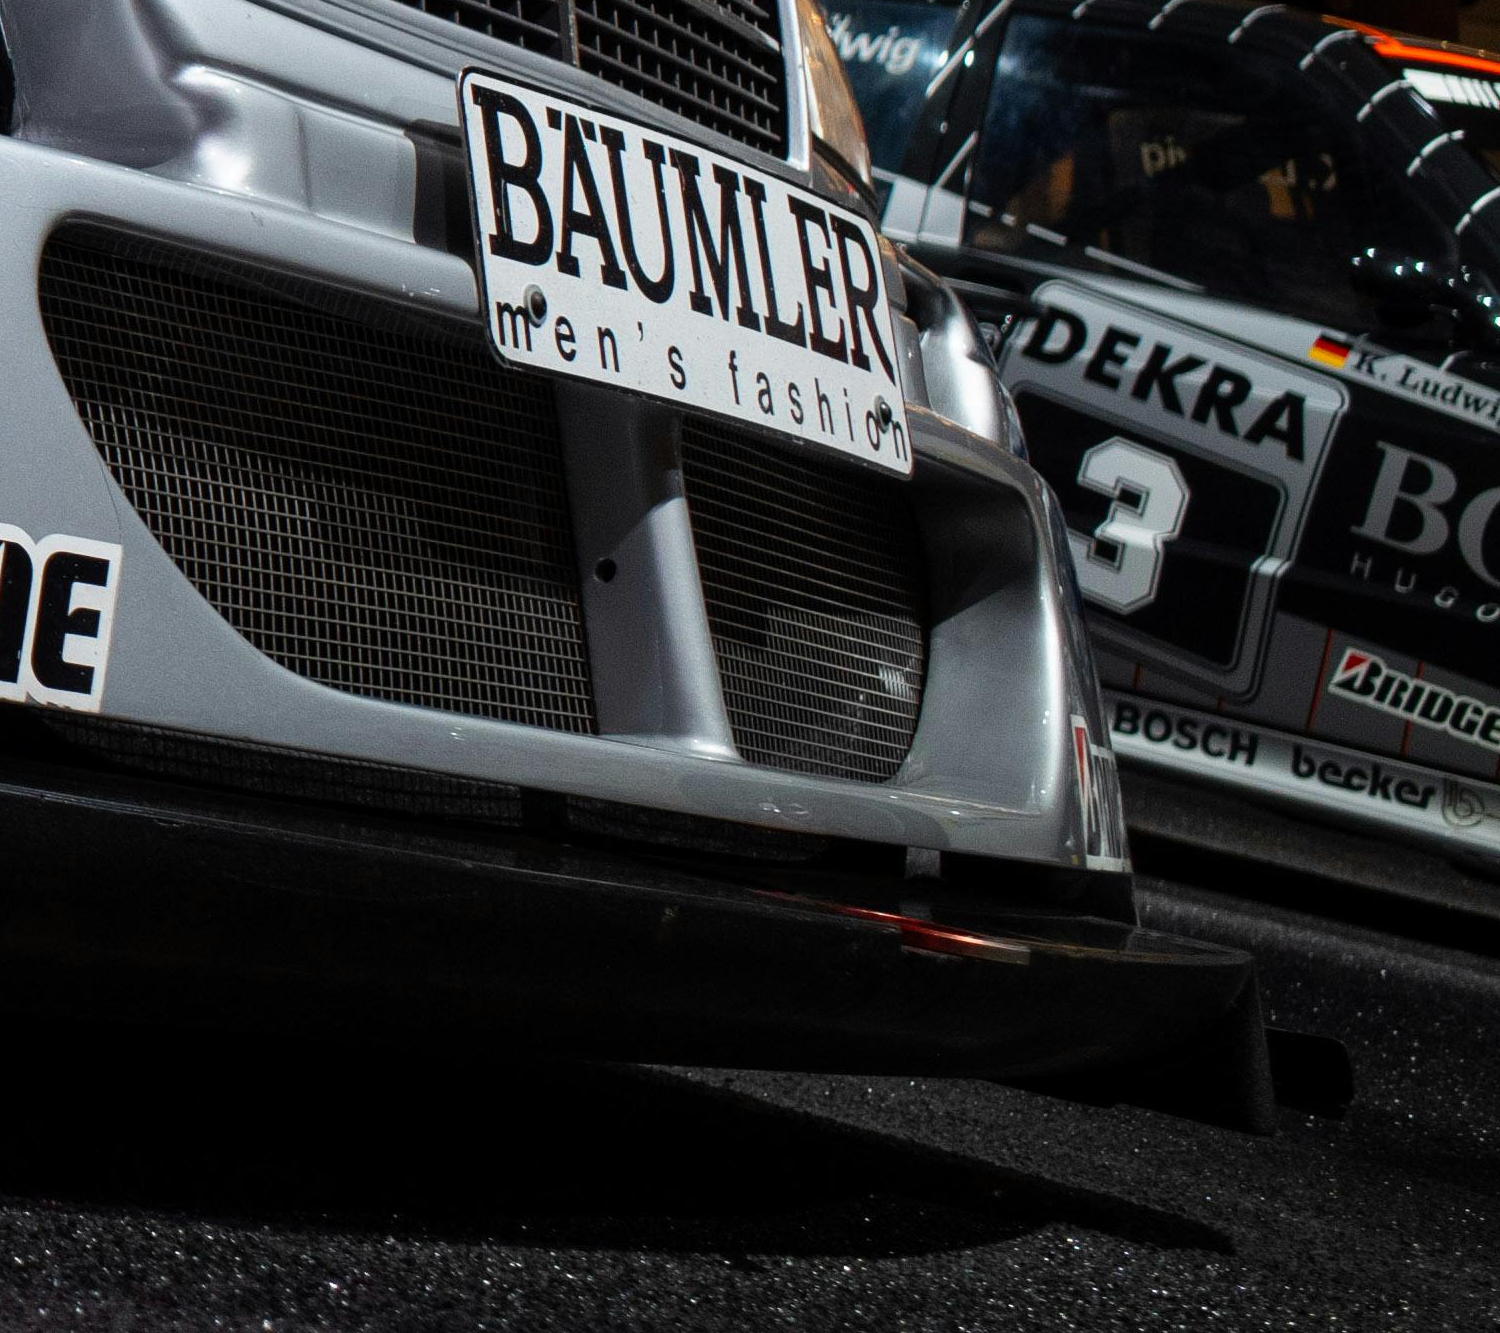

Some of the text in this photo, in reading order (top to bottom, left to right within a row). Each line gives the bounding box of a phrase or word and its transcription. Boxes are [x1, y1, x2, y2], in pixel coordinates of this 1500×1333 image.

[470, 82, 897, 389] BÄUMLER
[495, 297, 908, 462] men's fashion
[1023, 305, 1308, 466] DEKRA
[1352, 349, 1389, 383] K.
[1076, 434, 1192, 617] 3
[1110, 701, 1259, 767] BOSCH
[1290, 741, 1437, 812] becker
